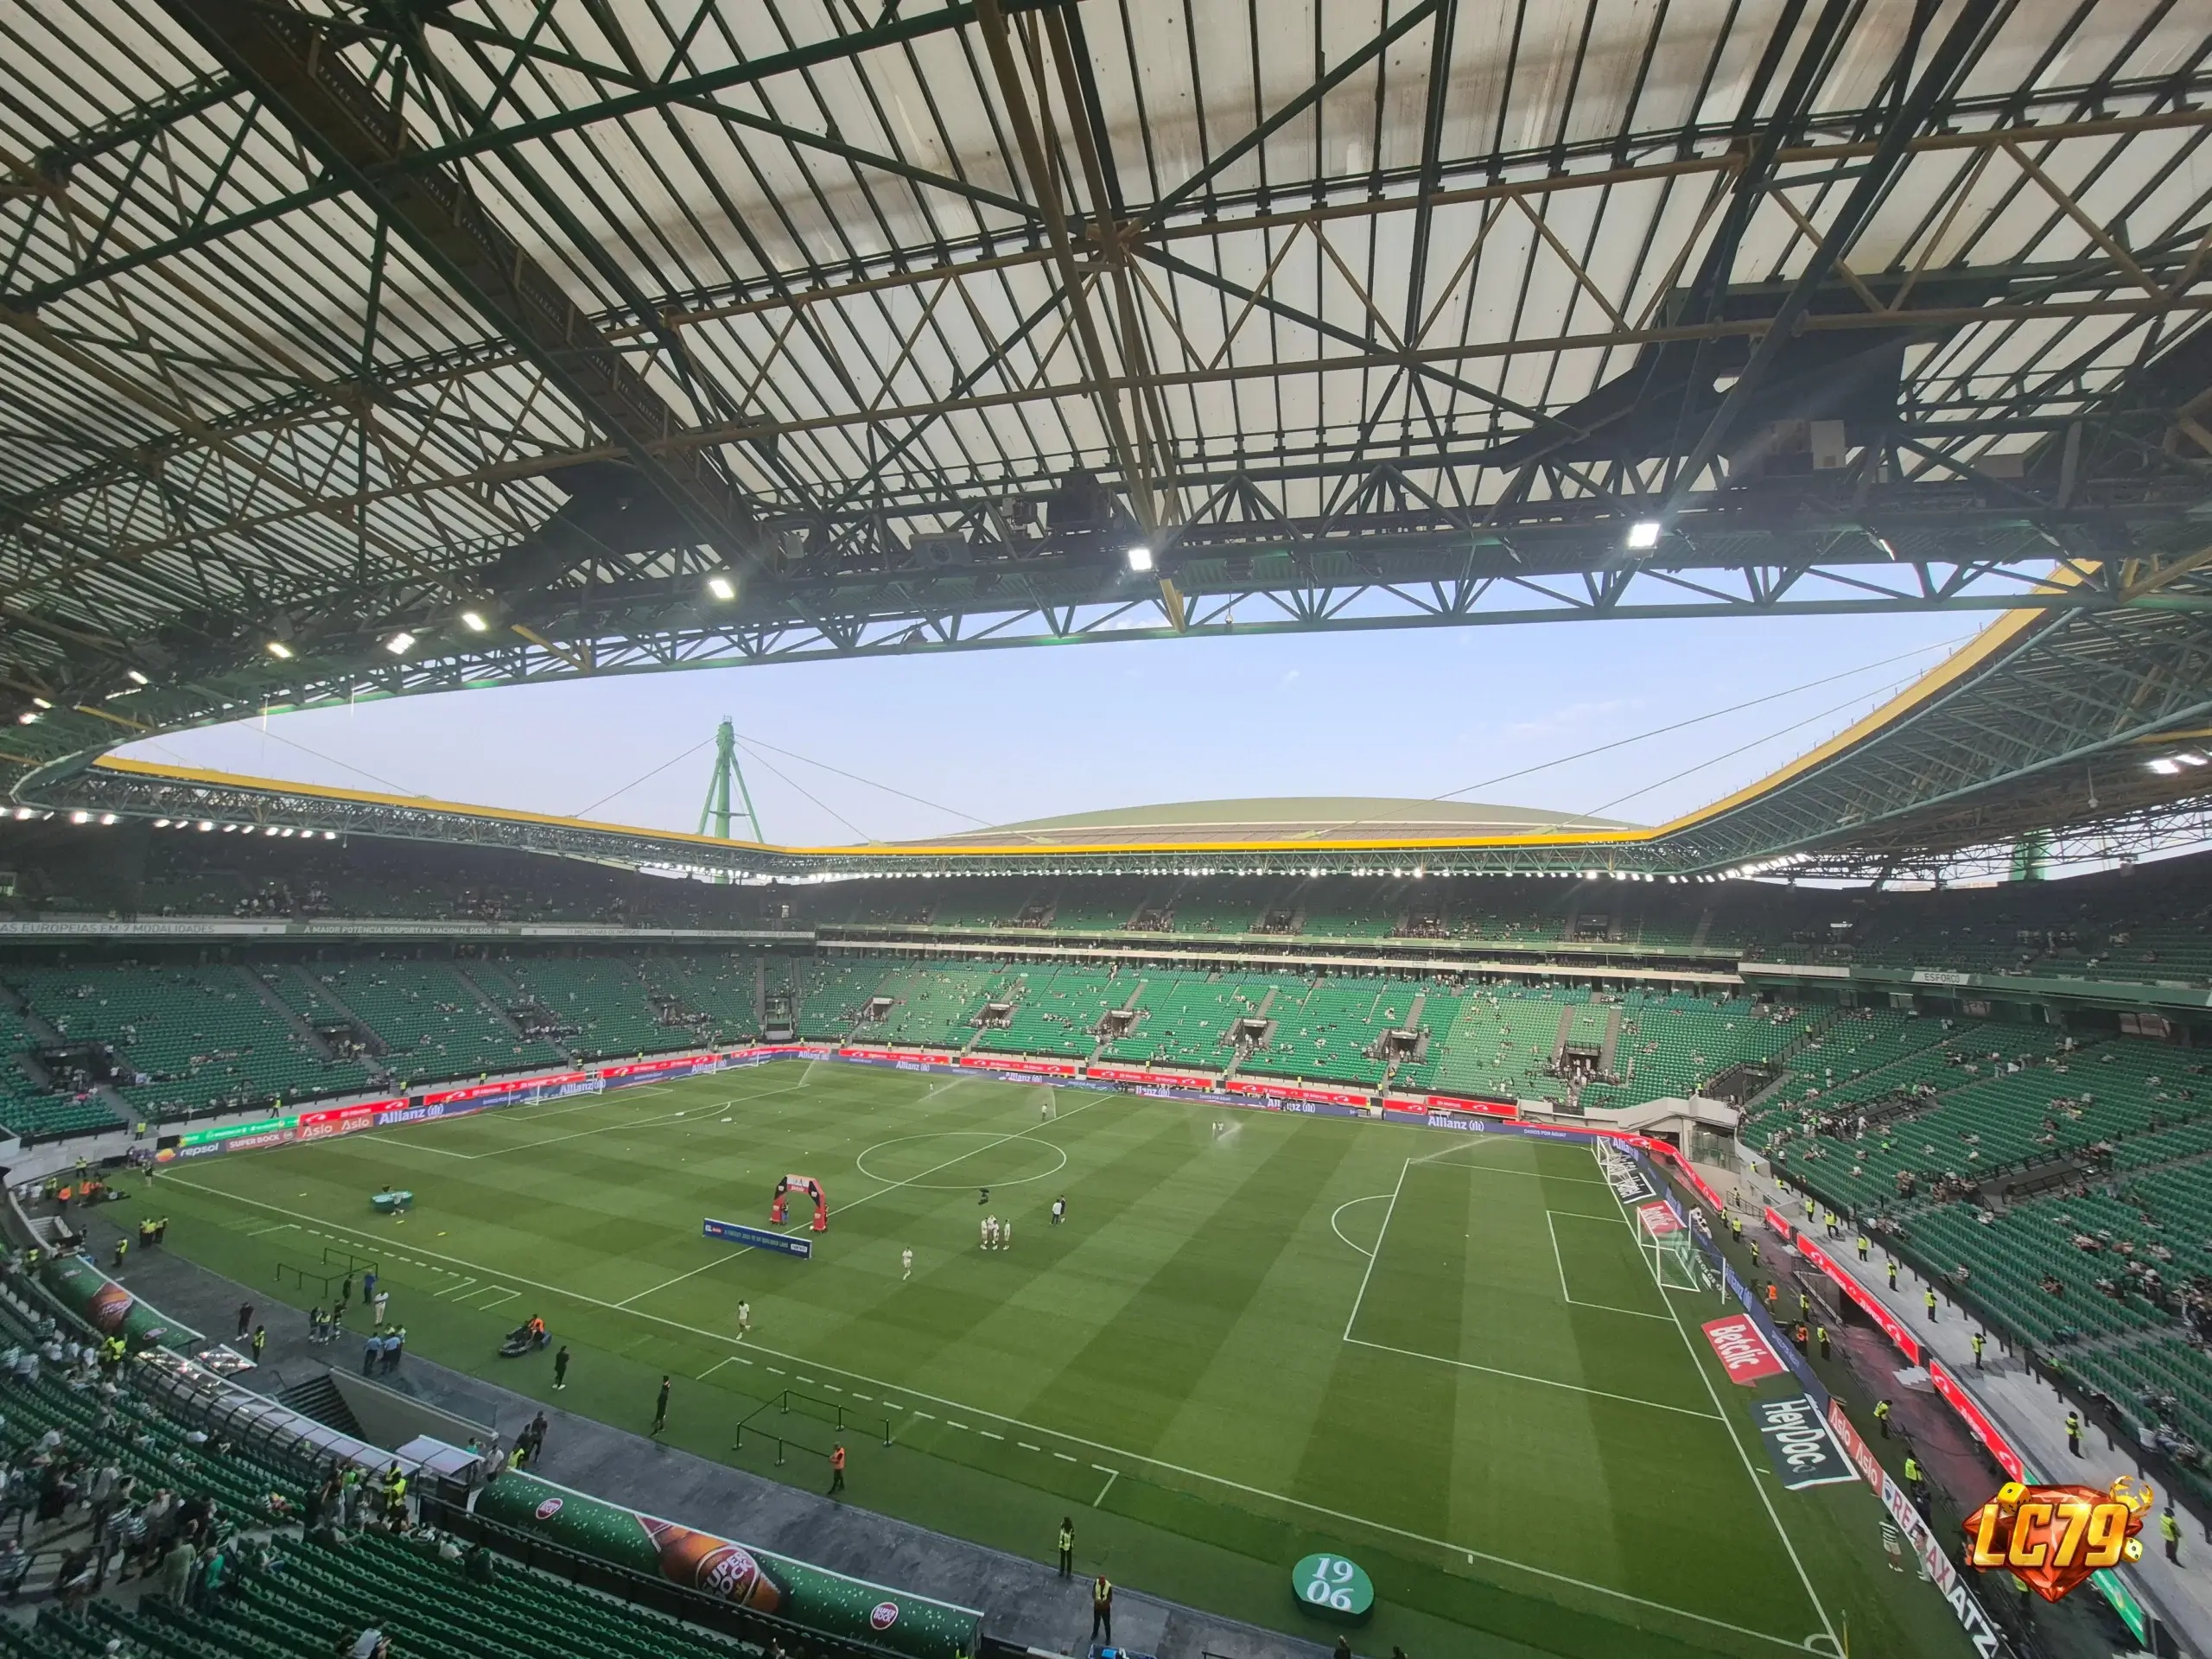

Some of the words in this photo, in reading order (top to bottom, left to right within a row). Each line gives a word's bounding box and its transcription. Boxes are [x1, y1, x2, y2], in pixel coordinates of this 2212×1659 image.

[22, 924, 97, 933] EUROPEIAS
[133, 925, 214, 933] MODALIDADES
[378, 1105, 425, 1125] Allianz
[1428, 1116, 1467, 1130] Allianz
[180, 1142, 219, 1157] repsol
[229, 1136, 256, 1148] SUPER
[257, 1134, 279, 1144] BOCK
[1709, 1324, 1768, 1370] Betclic
[1761, 1398, 1827, 1465] HeyDoc
[1312, 1558, 1353, 1583] 19
[1306, 1580, 1355, 1611] 06
